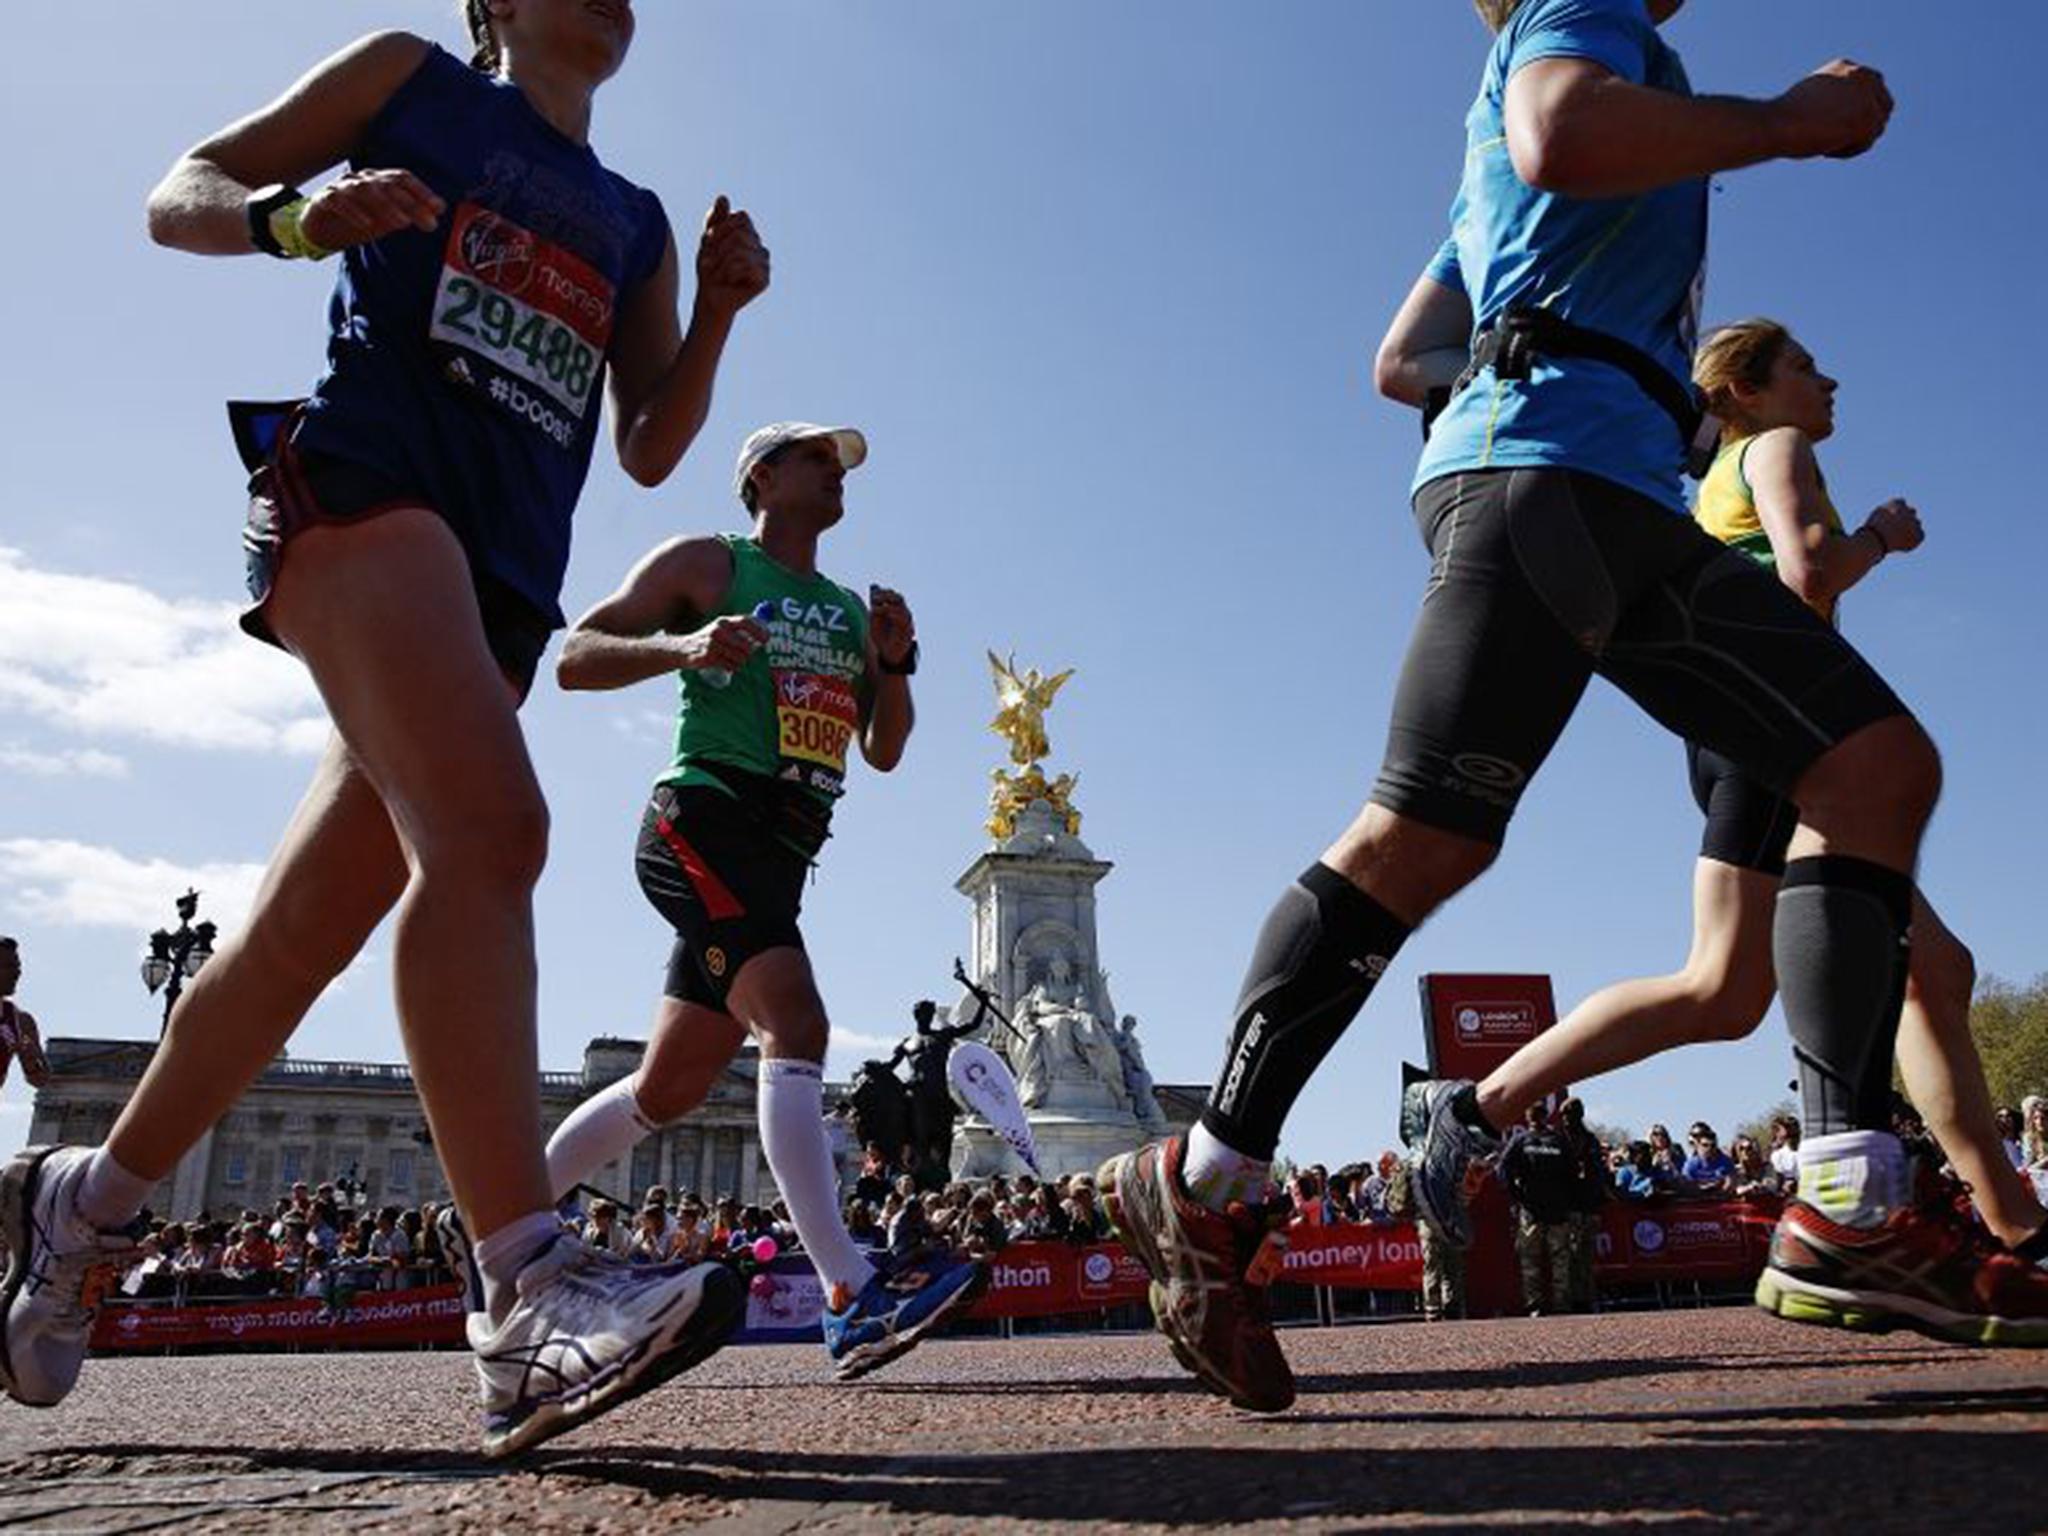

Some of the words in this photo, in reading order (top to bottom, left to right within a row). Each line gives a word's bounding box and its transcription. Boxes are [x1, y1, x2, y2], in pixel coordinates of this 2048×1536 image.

[539, 266, 613, 327] money
[440, 277, 595, 398] 29488
[489, 376, 574, 446] #boost
[782, 597, 849, 632] GAZ
[992, 1264, 1050, 1288] thon
[1283, 1243, 1371, 1270] money
[1379, 1238, 1424, 1262] lon
